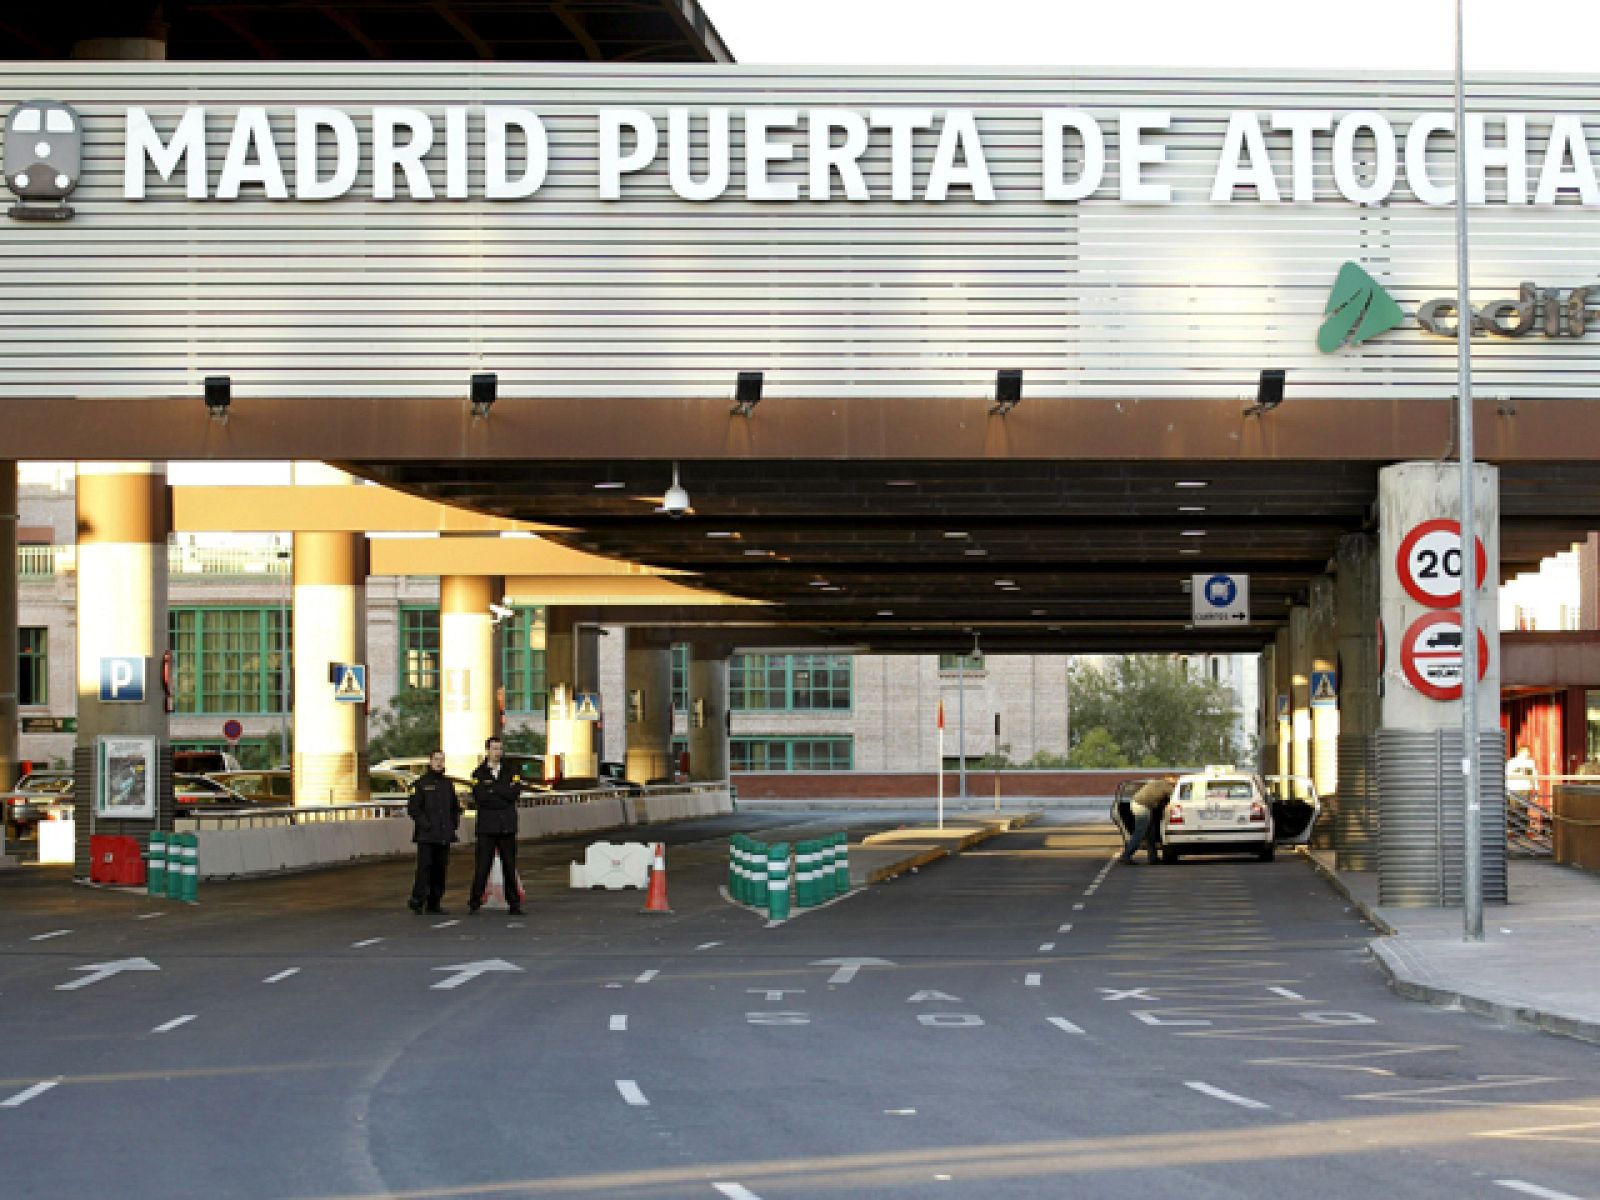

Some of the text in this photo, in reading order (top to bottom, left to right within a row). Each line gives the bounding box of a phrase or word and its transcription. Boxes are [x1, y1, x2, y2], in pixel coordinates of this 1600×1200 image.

[123, 105, 1600, 206] MADRID PUERTA DE ATOCHA
[1417, 549, 1463, 578] 20
[111, 660, 132, 698] P
